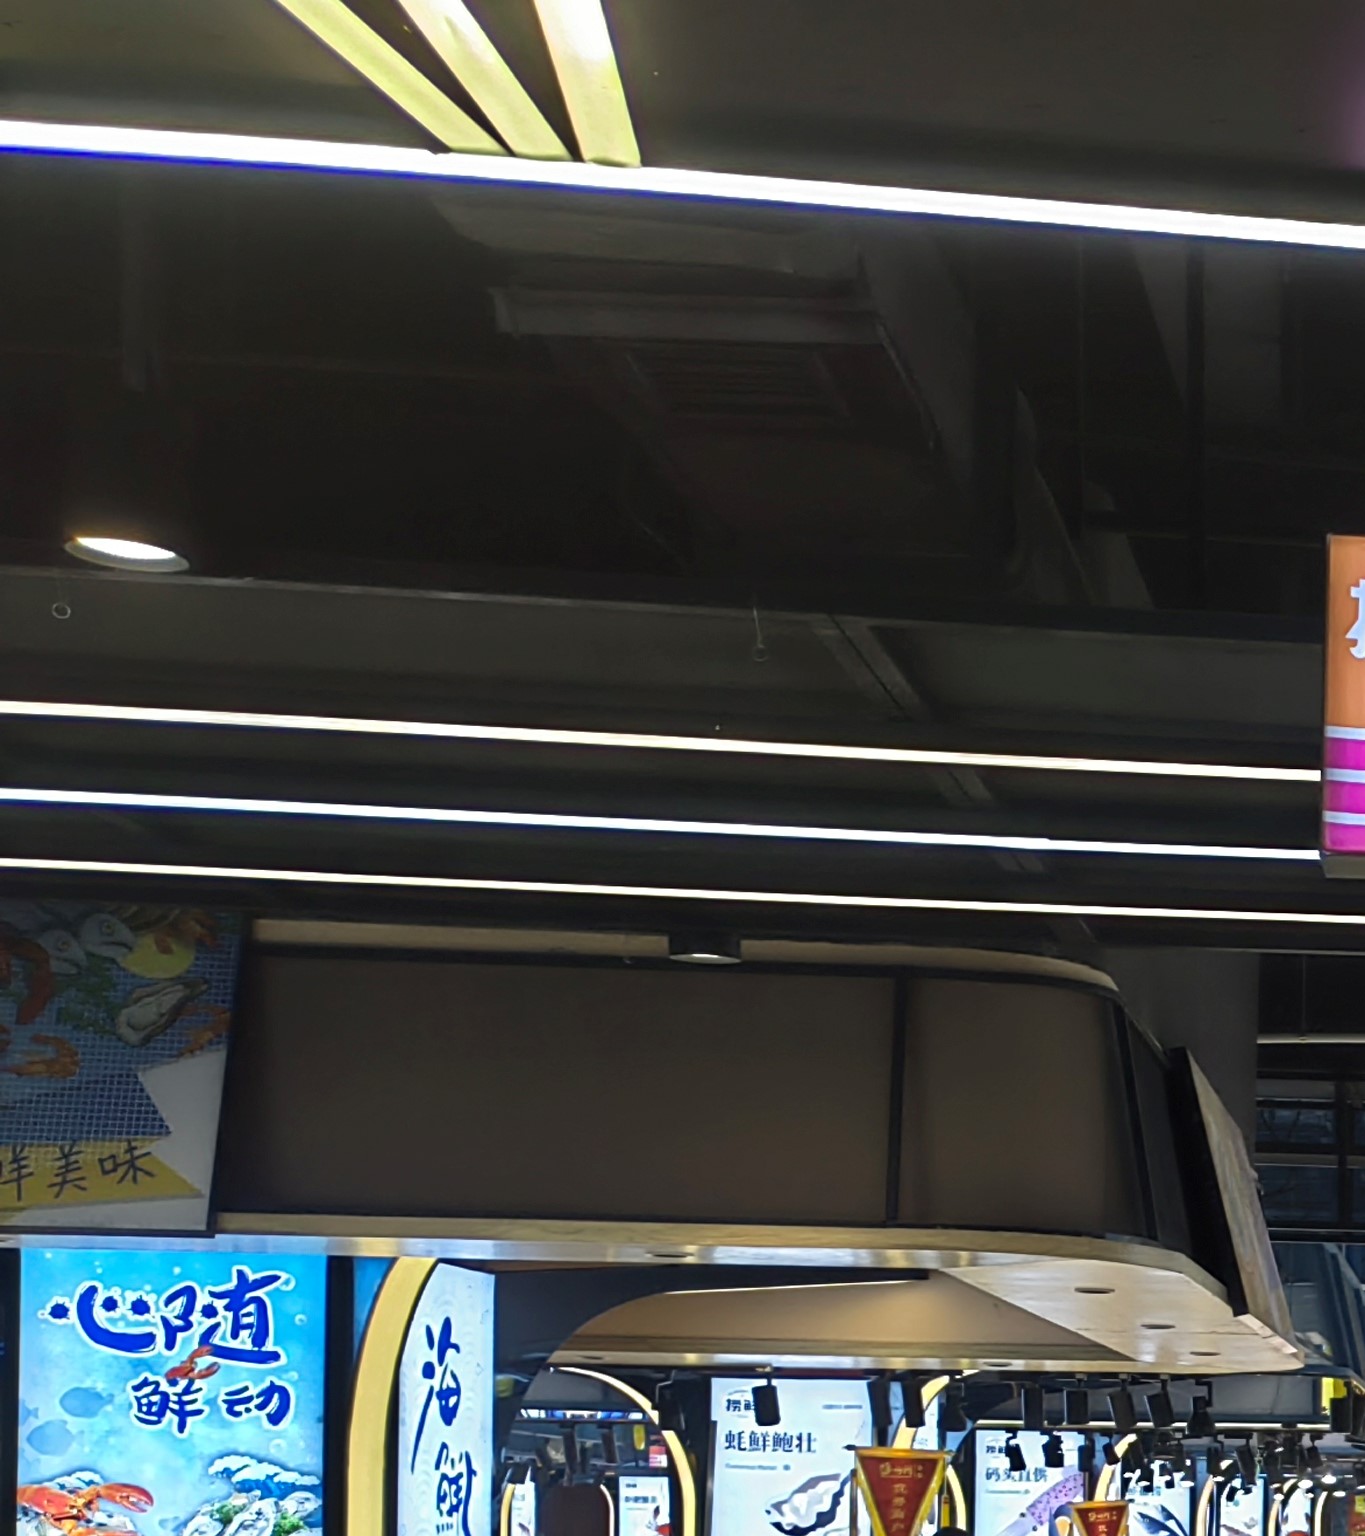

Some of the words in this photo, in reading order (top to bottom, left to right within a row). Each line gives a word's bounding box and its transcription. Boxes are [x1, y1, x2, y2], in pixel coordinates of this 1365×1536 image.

[131, 1376, 292, 1434] 鲜动
[724, 1429, 817, 1453] 蚝鲜鲍壮
